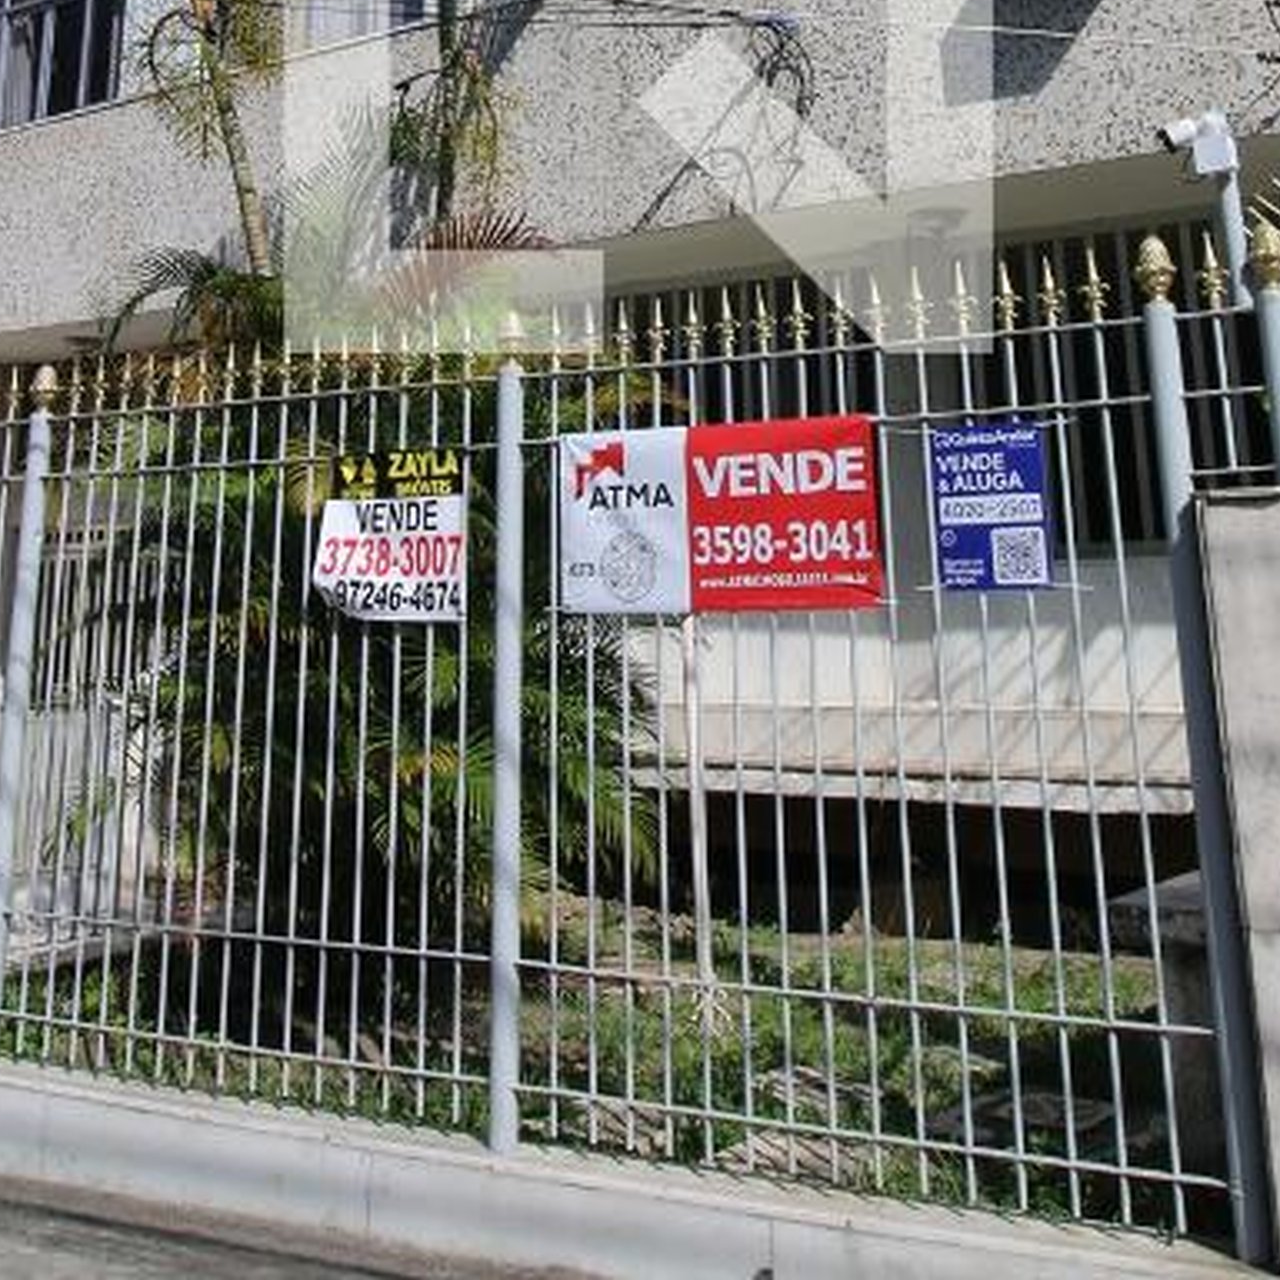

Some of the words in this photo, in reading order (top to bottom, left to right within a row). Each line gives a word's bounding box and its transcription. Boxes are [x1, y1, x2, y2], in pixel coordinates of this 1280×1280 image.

[388, 450, 459, 478] ZAYLA
[692, 445, 868, 498] VENDE
[935, 452, 1006, 473] VENDE
[589, 482, 674, 510] ATMA
[952, 470, 1024, 493] ALUGA
[356, 500, 438, 533] VENDE
[320, 536, 462, 577] 3738-3007
[692, 519, 873, 565] 3598-3041
